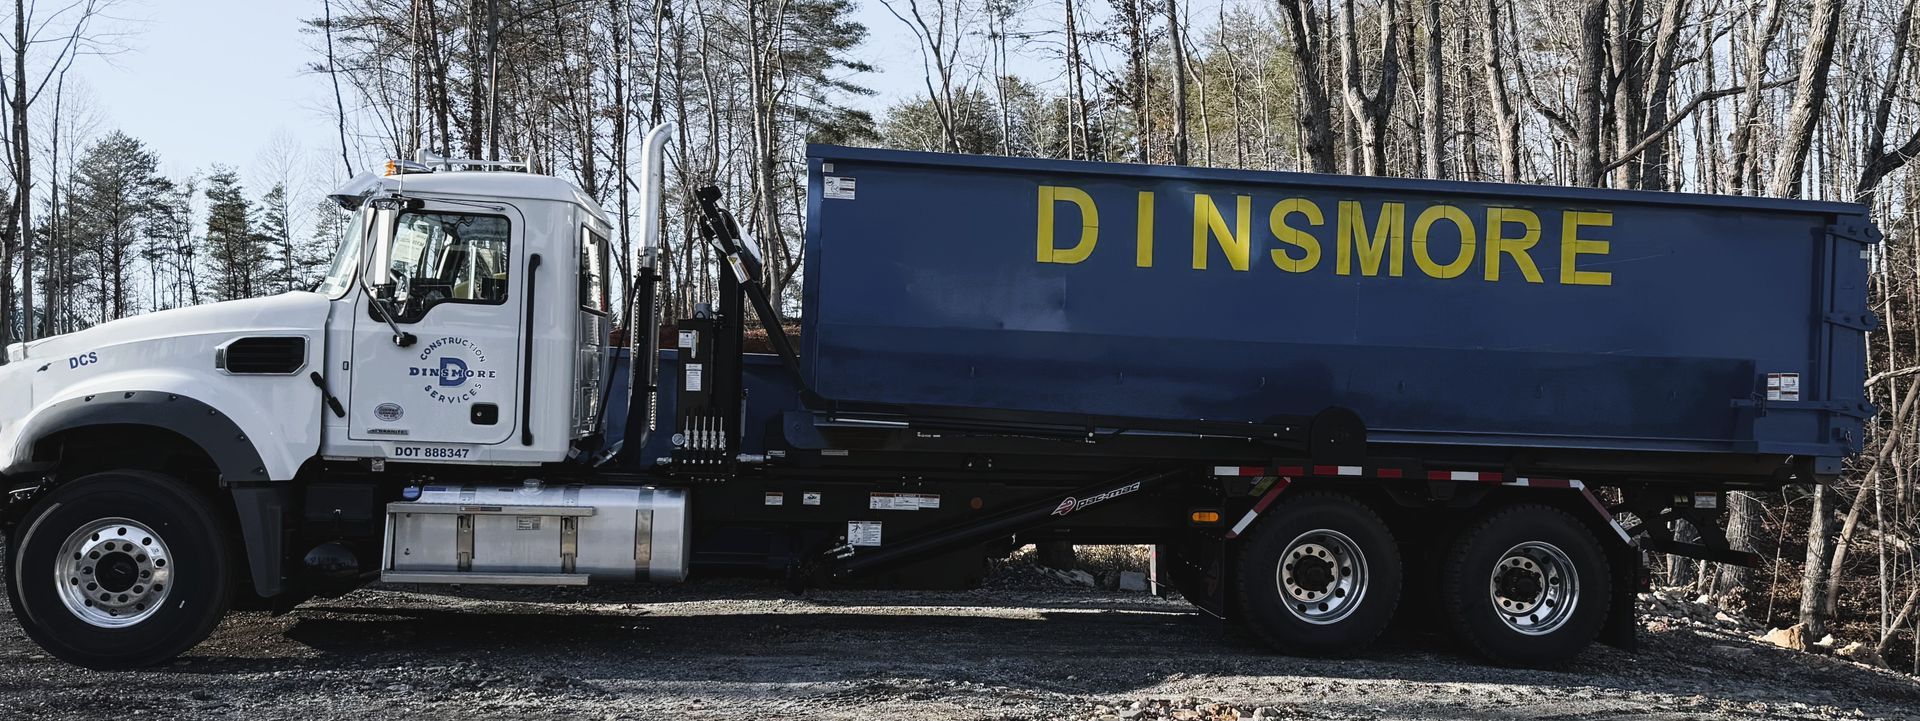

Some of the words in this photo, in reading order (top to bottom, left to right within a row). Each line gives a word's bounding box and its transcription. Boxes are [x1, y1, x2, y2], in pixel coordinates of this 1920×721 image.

[1036, 185, 1613, 285] DINSMORE
[69, 351, 98, 370] DCS
[420, 337, 486, 362] CONSTRUCTION
[409, 367, 496, 378] DINSMORE
[424, 382, 482, 404] SERVICES
[395, 447, 421, 457] DOT
[424, 448, 470, 458] 888347
[1076, 482, 1141, 511] pac-mac
